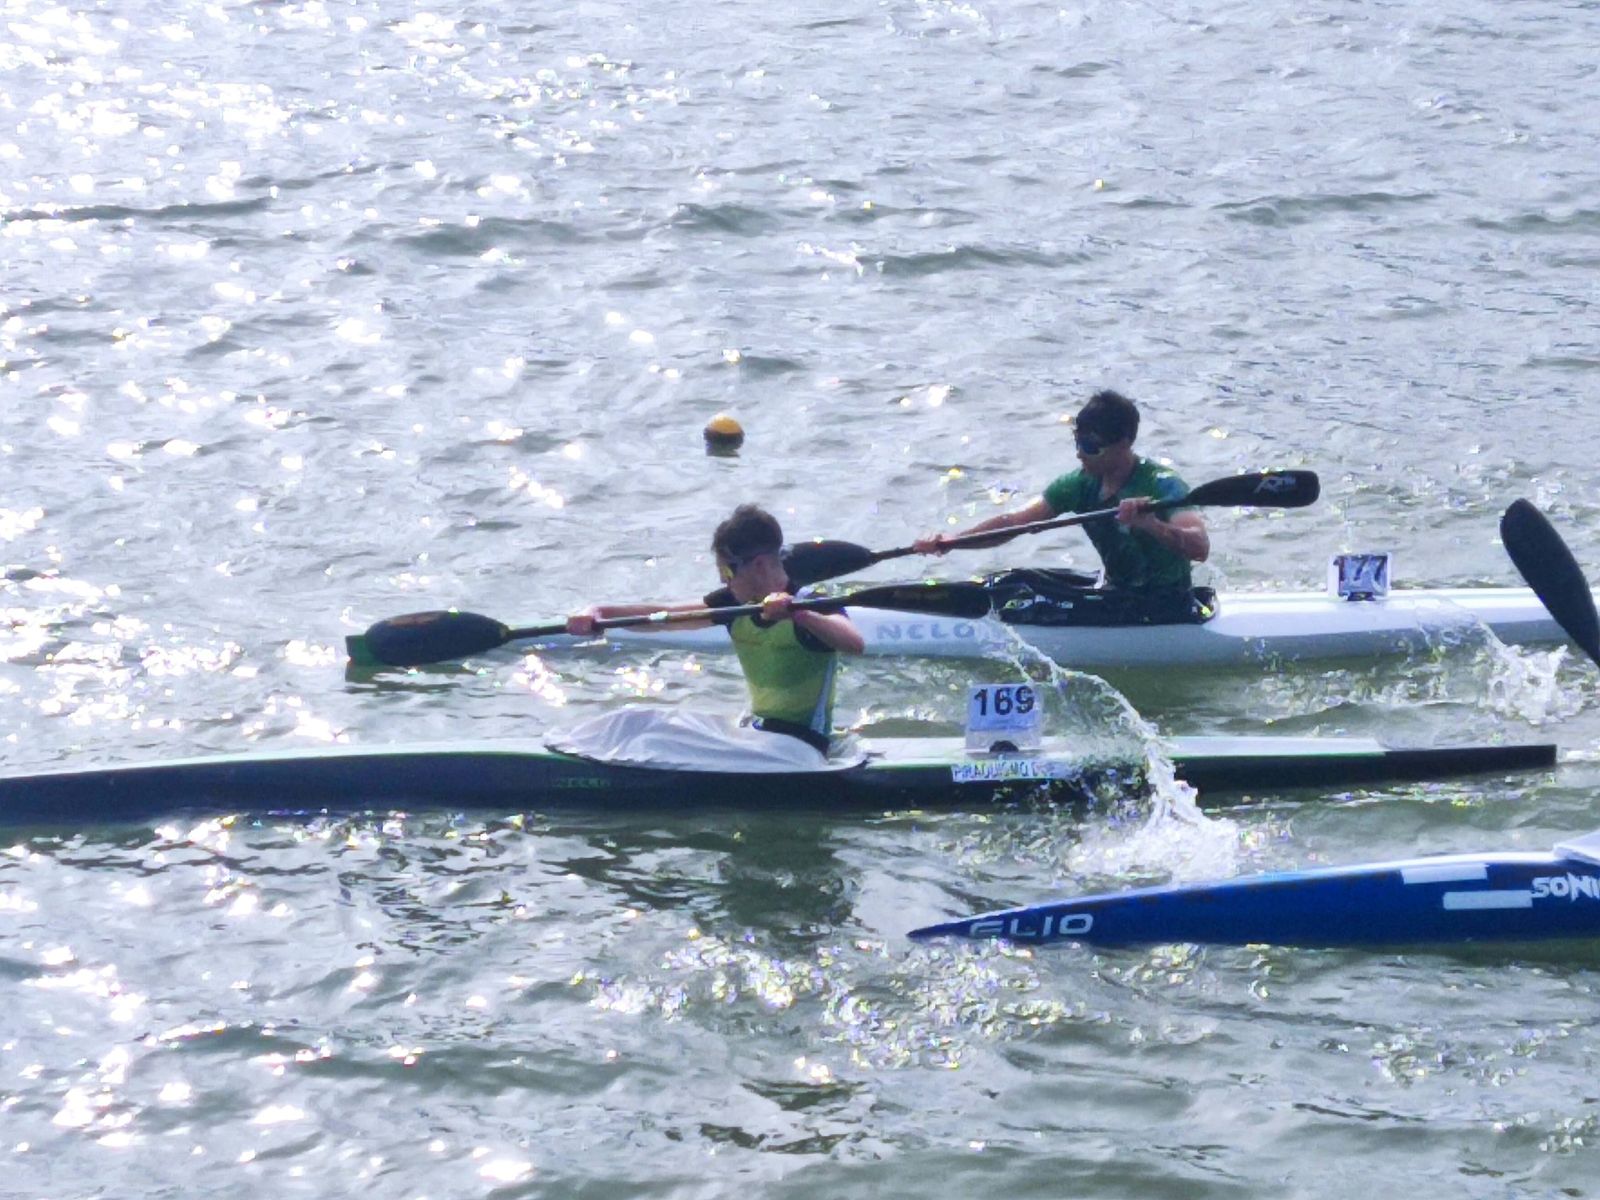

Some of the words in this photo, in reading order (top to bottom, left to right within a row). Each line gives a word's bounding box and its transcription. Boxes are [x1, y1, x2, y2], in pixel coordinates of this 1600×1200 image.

[1333, 555, 1388, 582] 177
[974, 685, 1035, 716] 169
[969, 913, 1094, 937] ELIO
